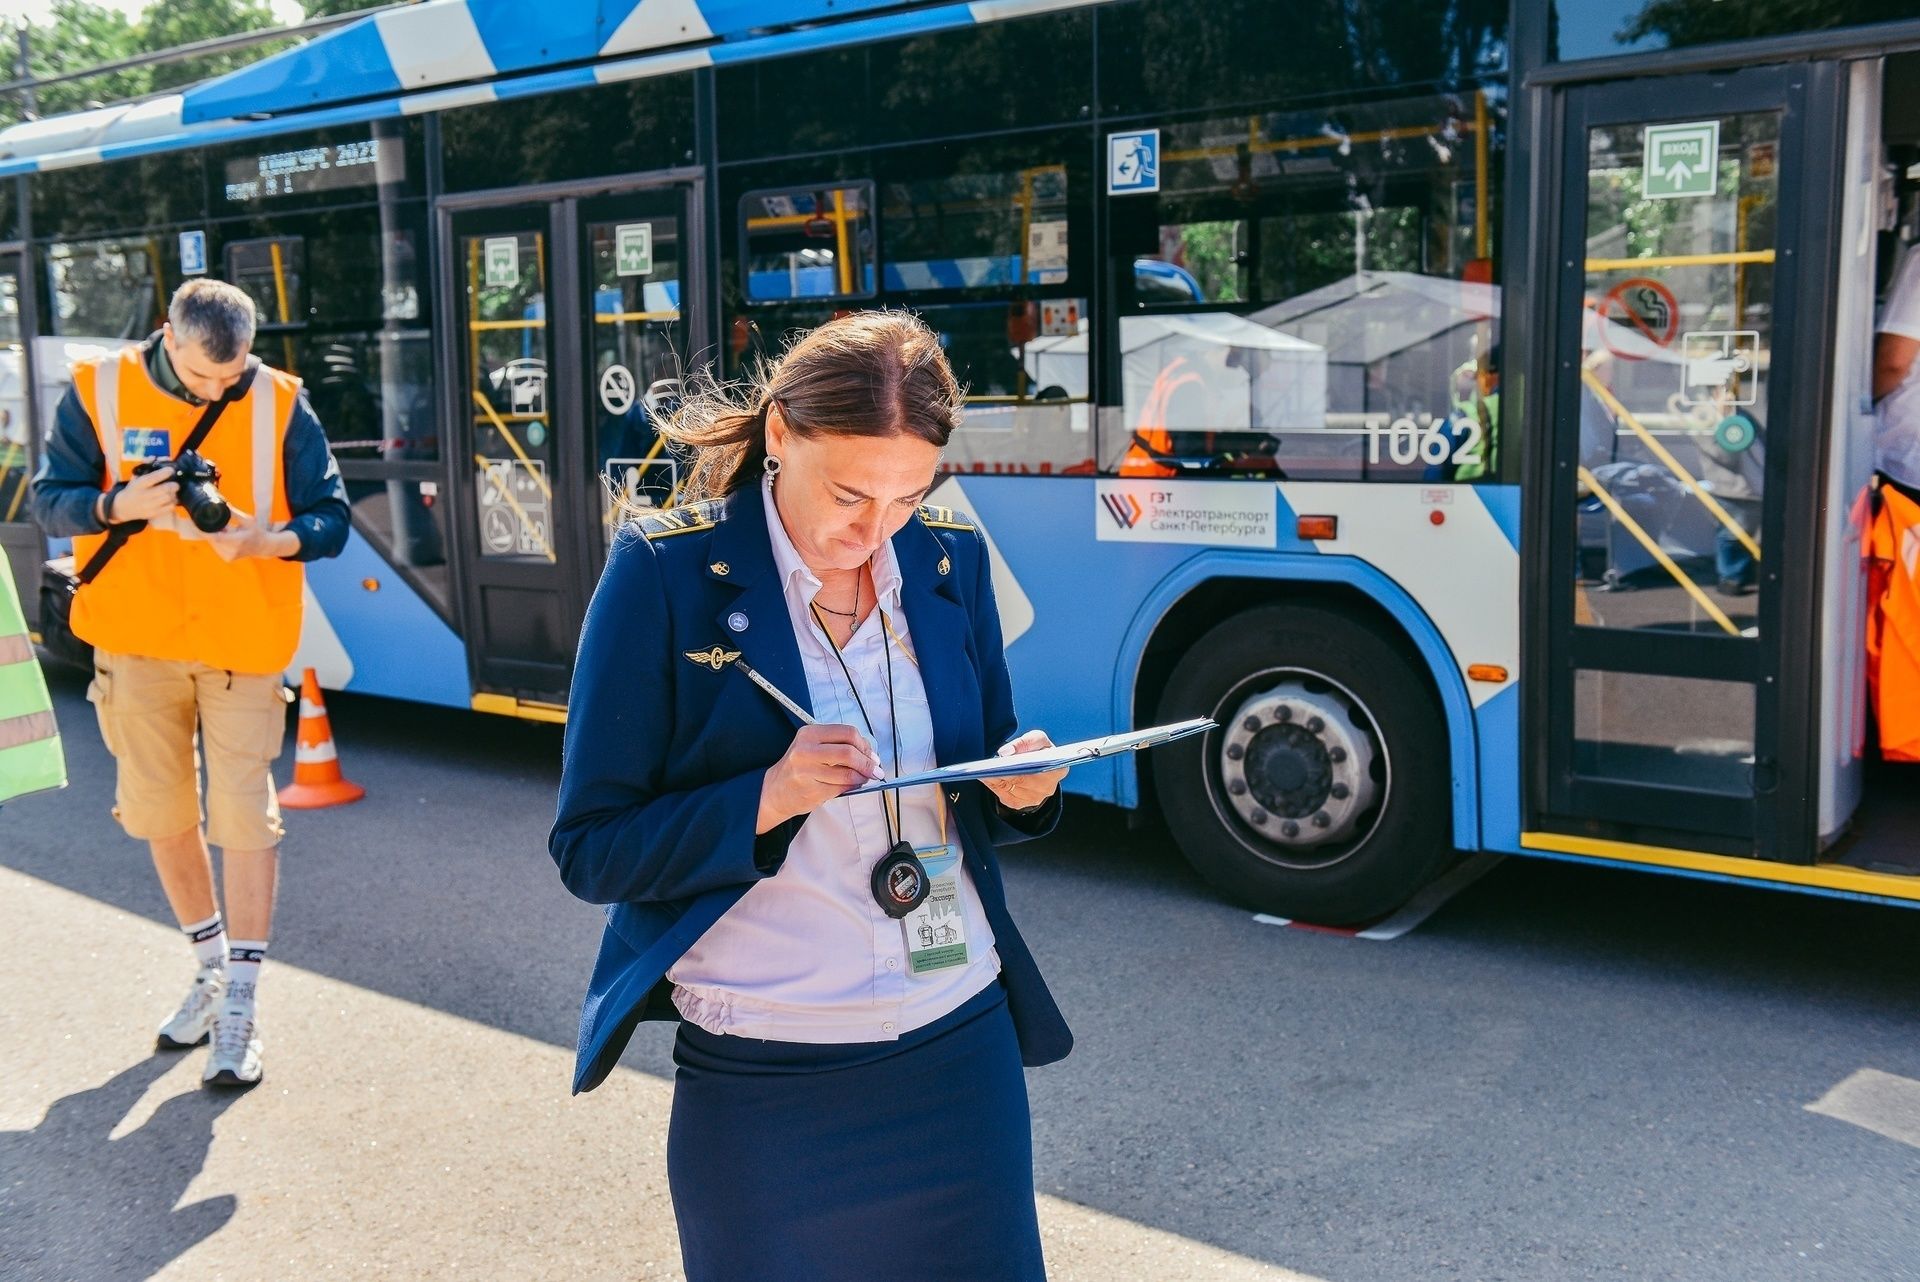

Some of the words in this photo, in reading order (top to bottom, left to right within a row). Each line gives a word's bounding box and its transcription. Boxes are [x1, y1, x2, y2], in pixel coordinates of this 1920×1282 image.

[1663, 141, 1699, 156] ВХОД
[1365, 418, 1481, 465] 1062
[1150, 492, 1173, 503] ГЭТ
[1151, 506, 1269, 523] Электротранспорт
[1150, 519, 1266, 536] Санкт-Петербурга
